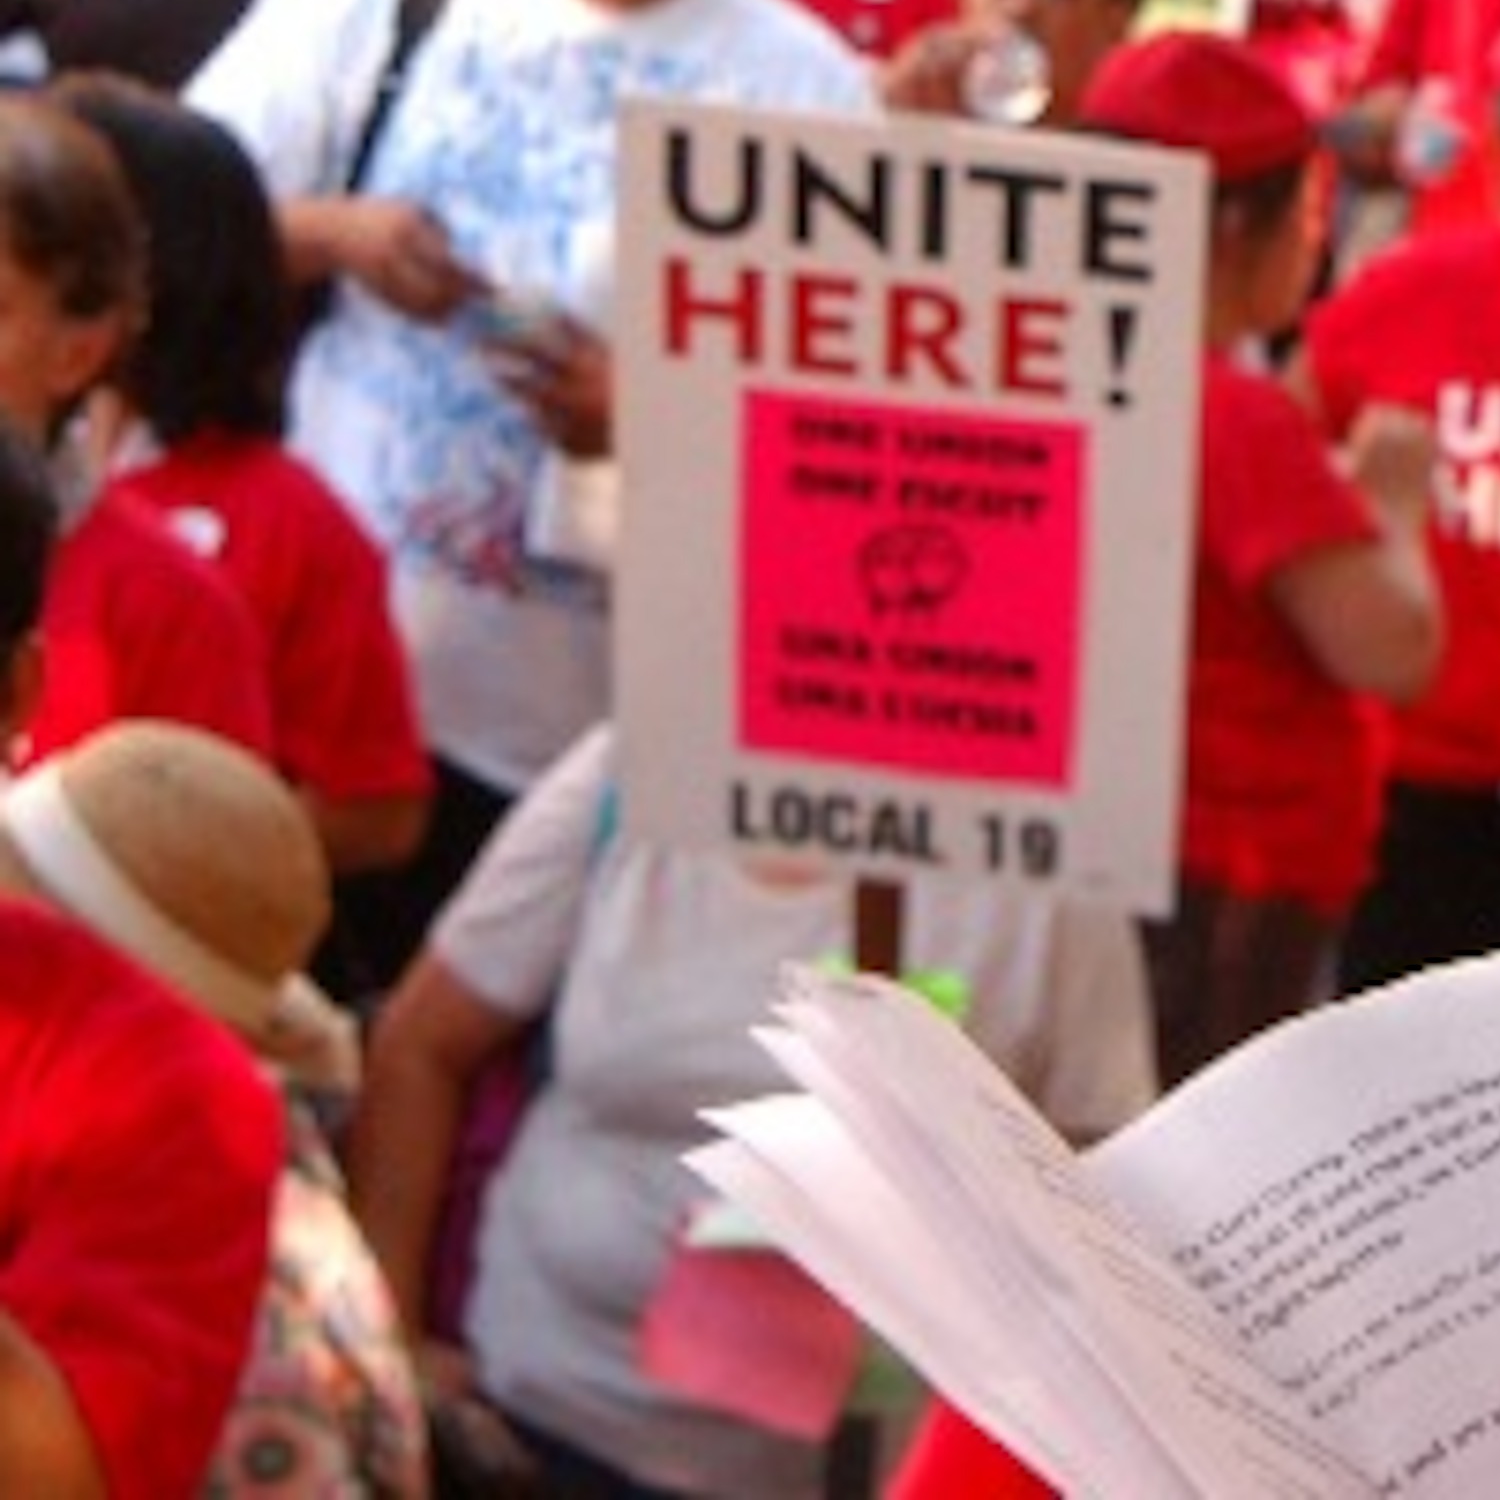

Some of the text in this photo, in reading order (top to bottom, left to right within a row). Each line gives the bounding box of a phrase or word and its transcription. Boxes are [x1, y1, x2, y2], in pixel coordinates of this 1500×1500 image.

[664, 127, 1156, 284] UNITE
[662, 255, 1138, 408] HERE!
[729, 782, 1060, 878] LOCAL 19
